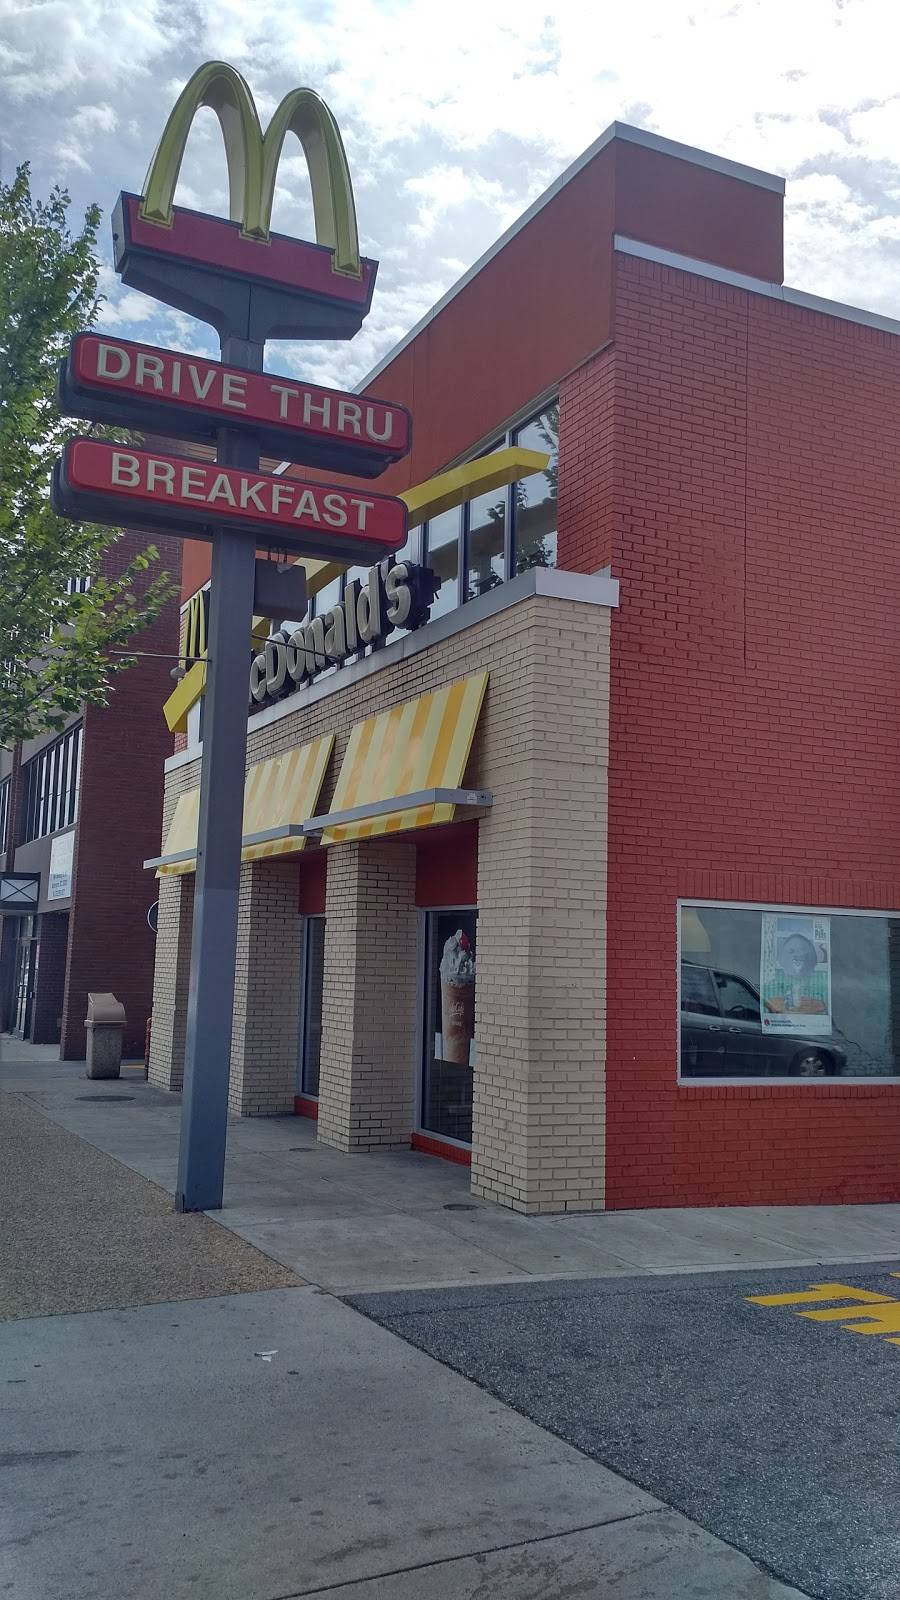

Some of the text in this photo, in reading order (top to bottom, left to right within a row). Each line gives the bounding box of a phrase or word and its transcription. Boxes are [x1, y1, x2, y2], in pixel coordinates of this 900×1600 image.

[96, 343, 393, 442] DRIVE THRU
[111, 452, 375, 532] BREAKFAST
[250, 554, 413, 702] cDonald's
